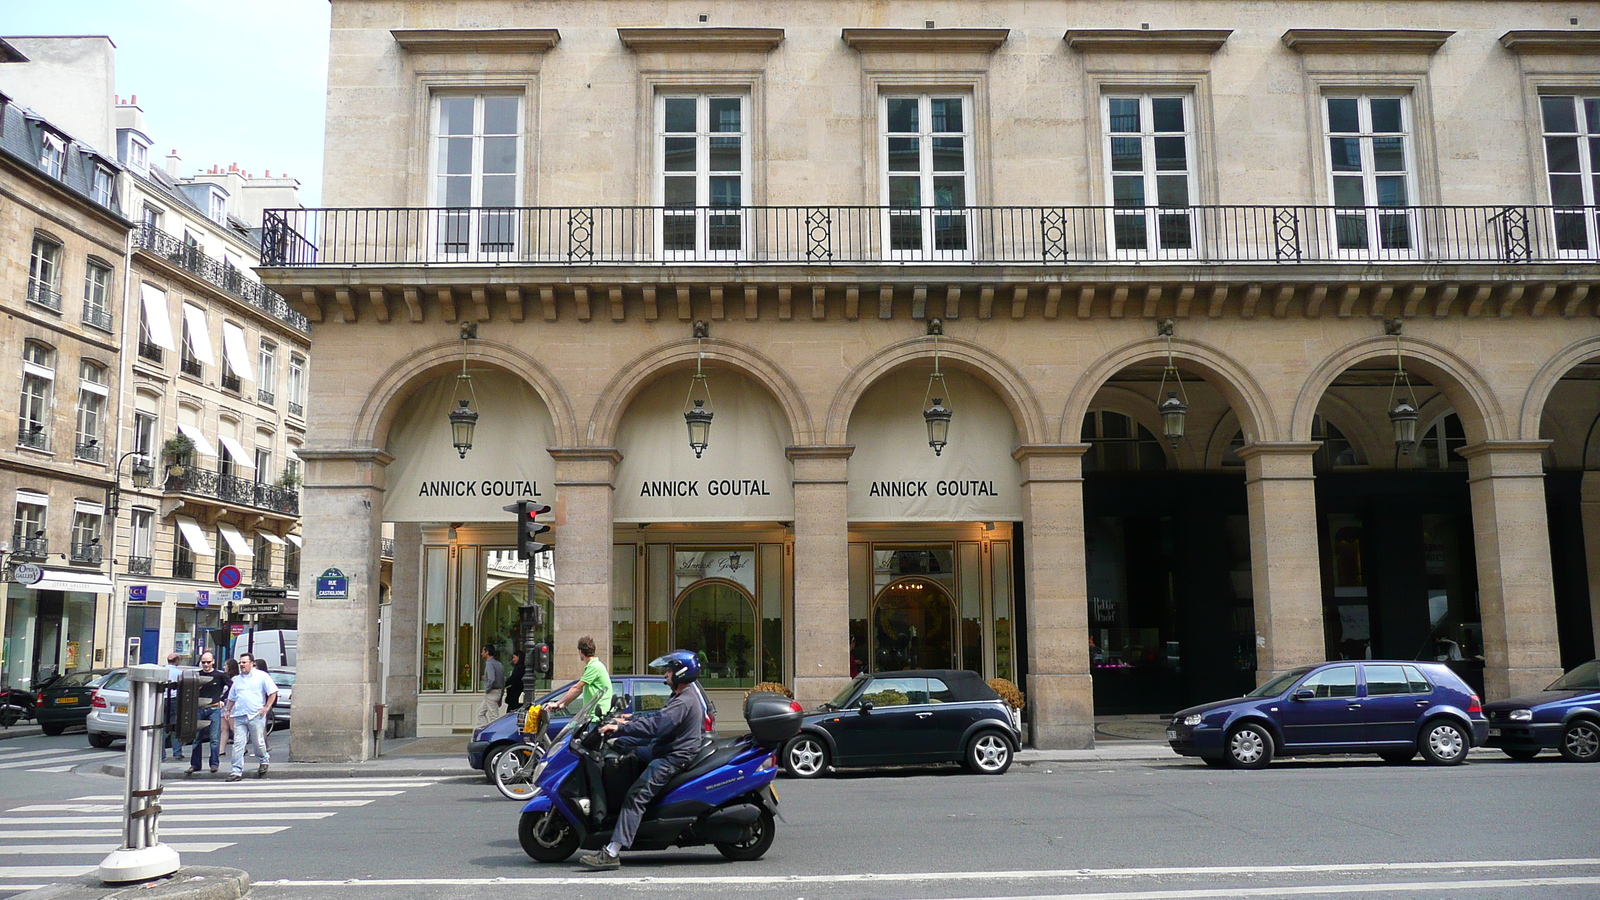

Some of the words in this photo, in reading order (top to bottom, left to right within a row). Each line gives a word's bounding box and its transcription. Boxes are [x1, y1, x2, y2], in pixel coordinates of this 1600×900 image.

[418, 480, 477, 497] ANNICK
[481, 480, 542, 497] GOUTAL
[640, 480, 699, 497] ANNICK
[707, 479, 771, 496] GOUTAL
[869, 480, 928, 497] ANNICK
[936, 480, 999, 497] GOUTAL
[16, 572, 39, 580] GALLERY
[19, 565, 38, 573] OPERA
